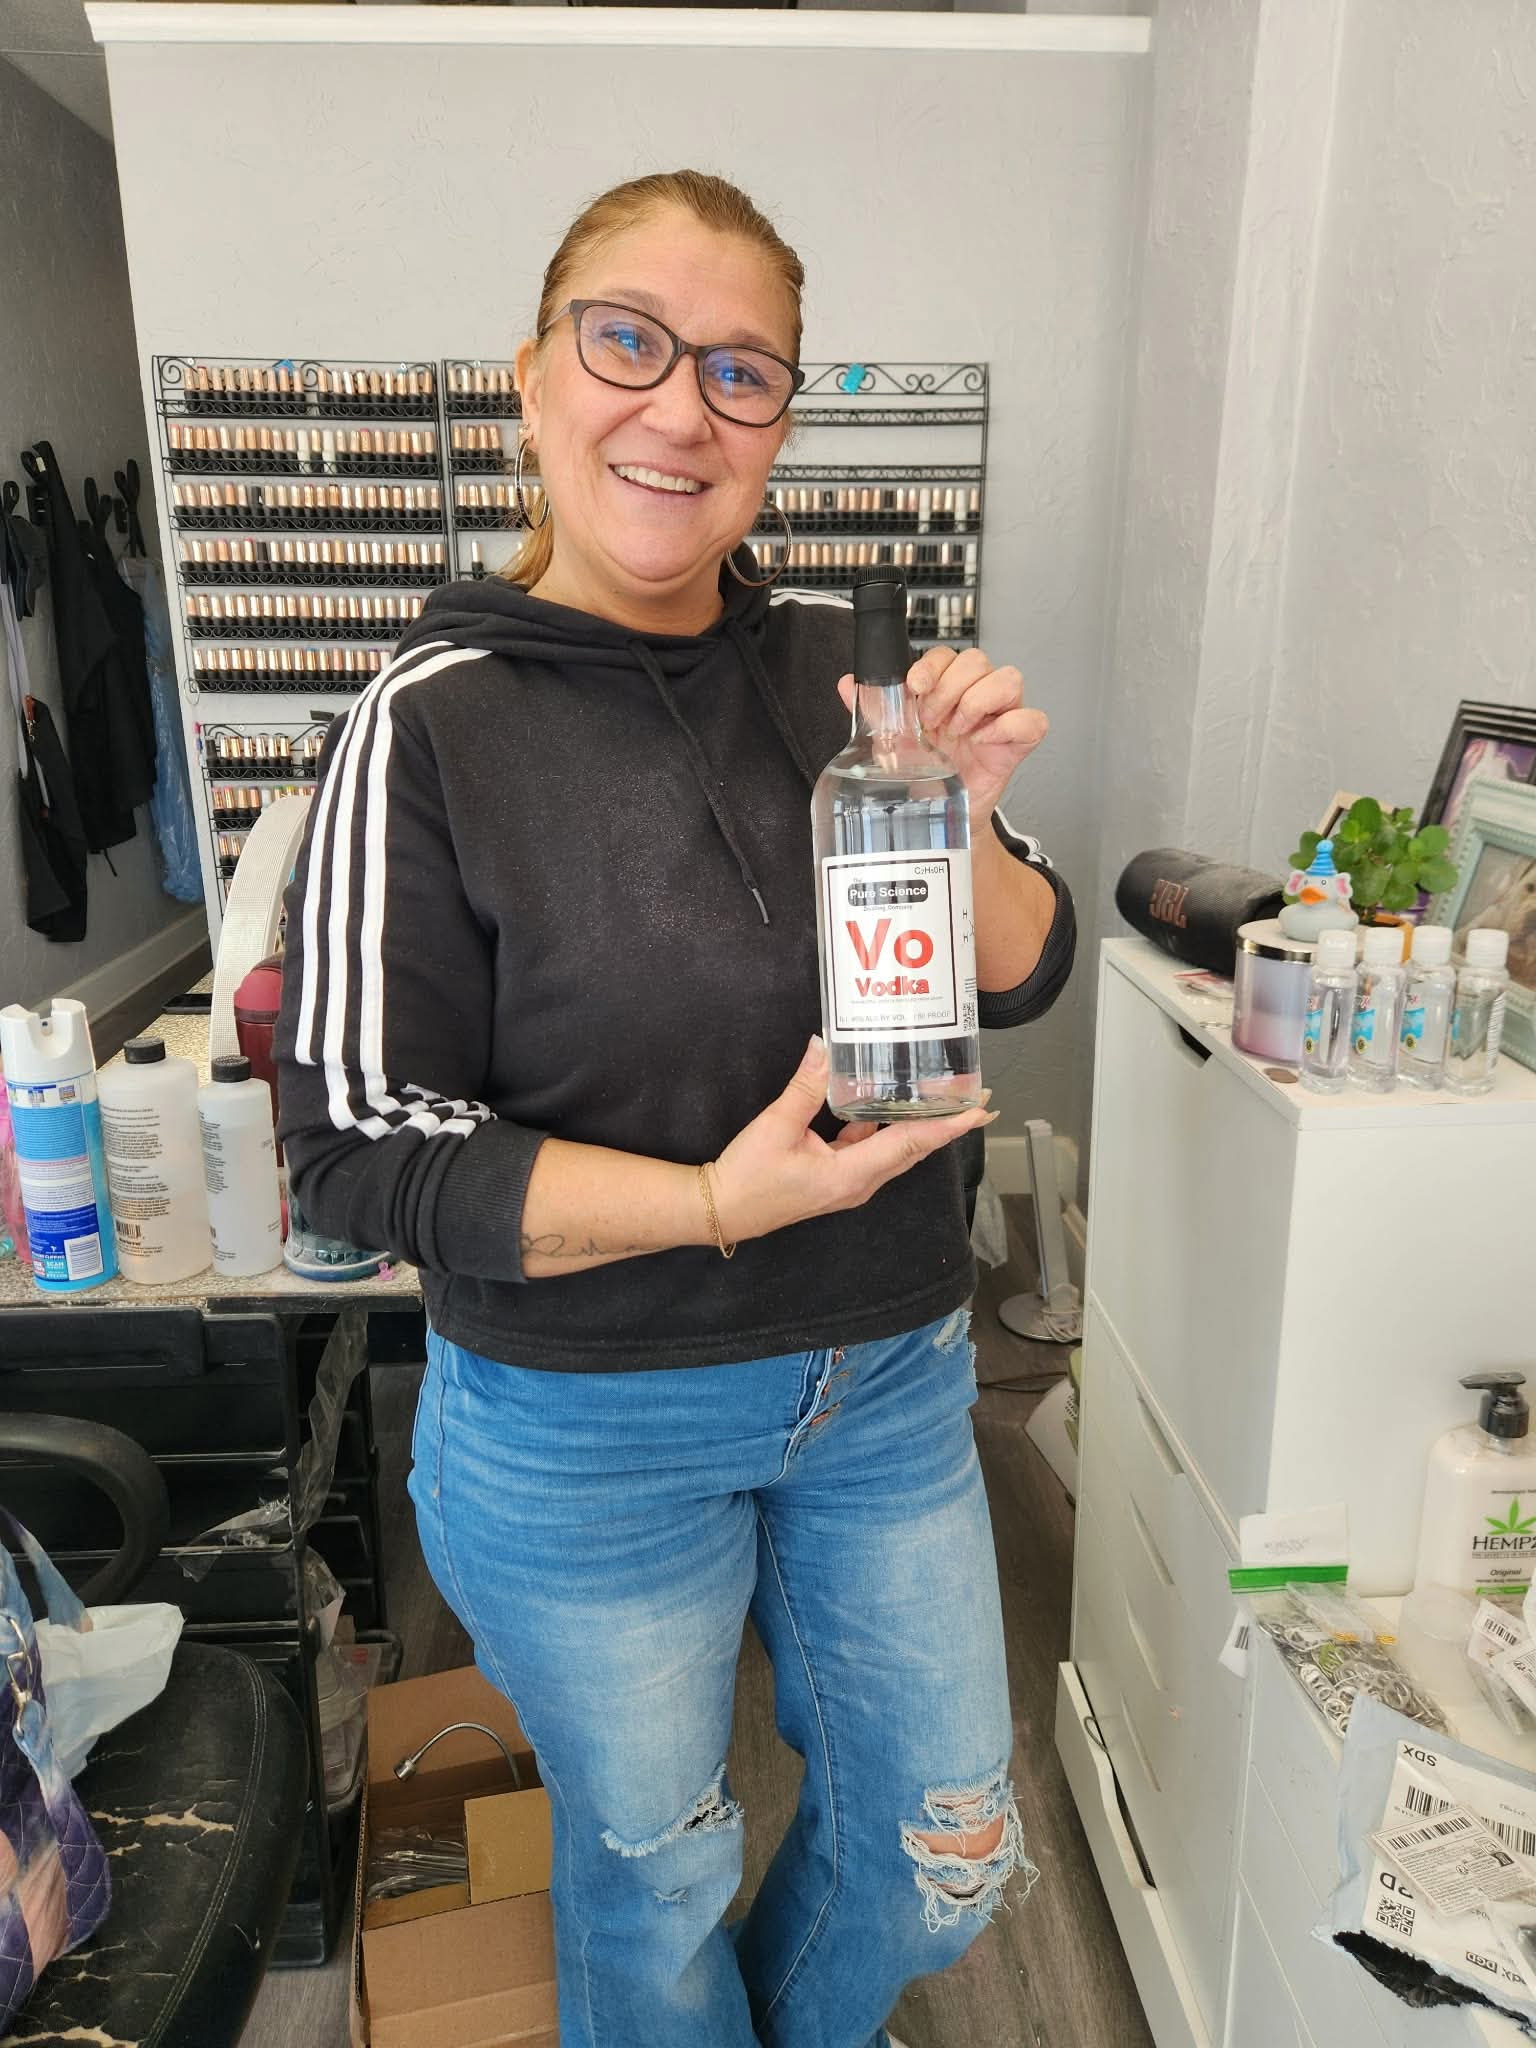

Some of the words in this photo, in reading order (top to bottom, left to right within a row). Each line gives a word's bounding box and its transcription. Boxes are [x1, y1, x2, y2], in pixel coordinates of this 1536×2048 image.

[850, 888, 876, 900] Pure
[879, 885, 927, 898] Science
[1149, 878, 1189, 929] JBL
[845, 918, 934, 971] Vo
[855, 976, 930, 997] Vodka
[1490, 1568, 1522, 1577] Original
[1402, 1744, 1437, 1767] SDX
[1467, 1952, 1497, 1972] DGD
